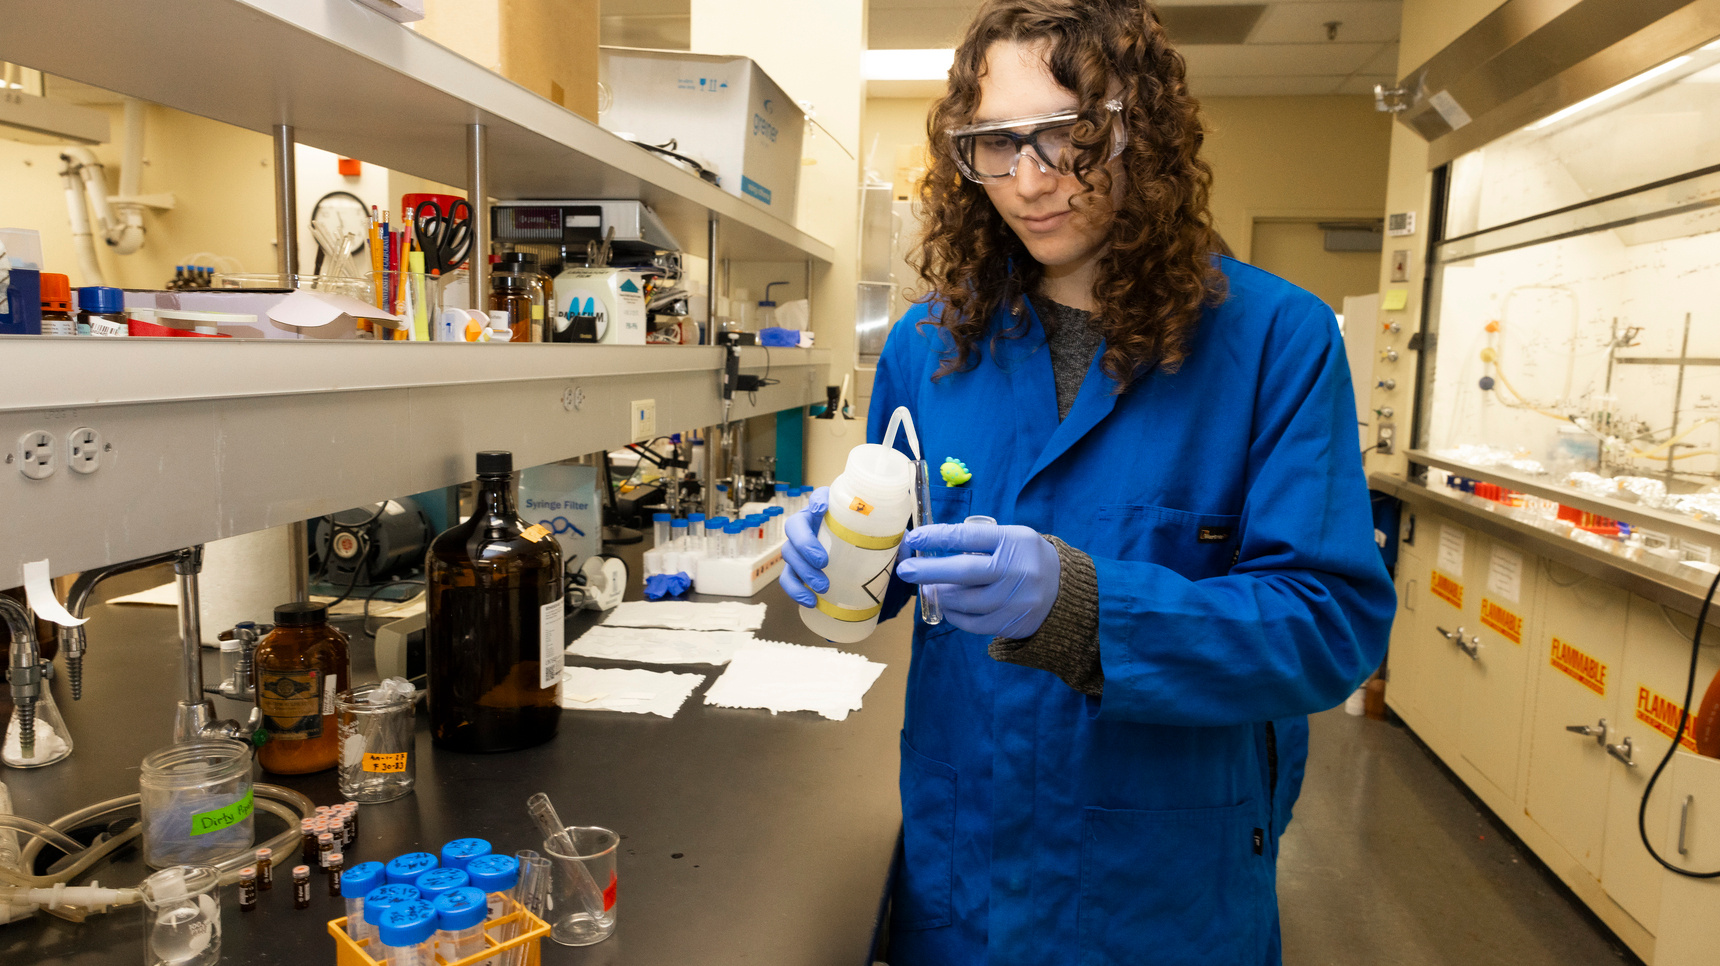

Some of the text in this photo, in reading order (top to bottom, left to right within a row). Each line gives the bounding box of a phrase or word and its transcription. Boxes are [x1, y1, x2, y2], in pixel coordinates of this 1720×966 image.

[753, 113, 778, 142] greiner
[526, 499, 589, 511] Syringe Filter
[1481, 598, 1522, 636] FLAMMABLE
[1551, 637, 1607, 686] FLAMMABLE
[201, 813, 234, 829] Dirty
